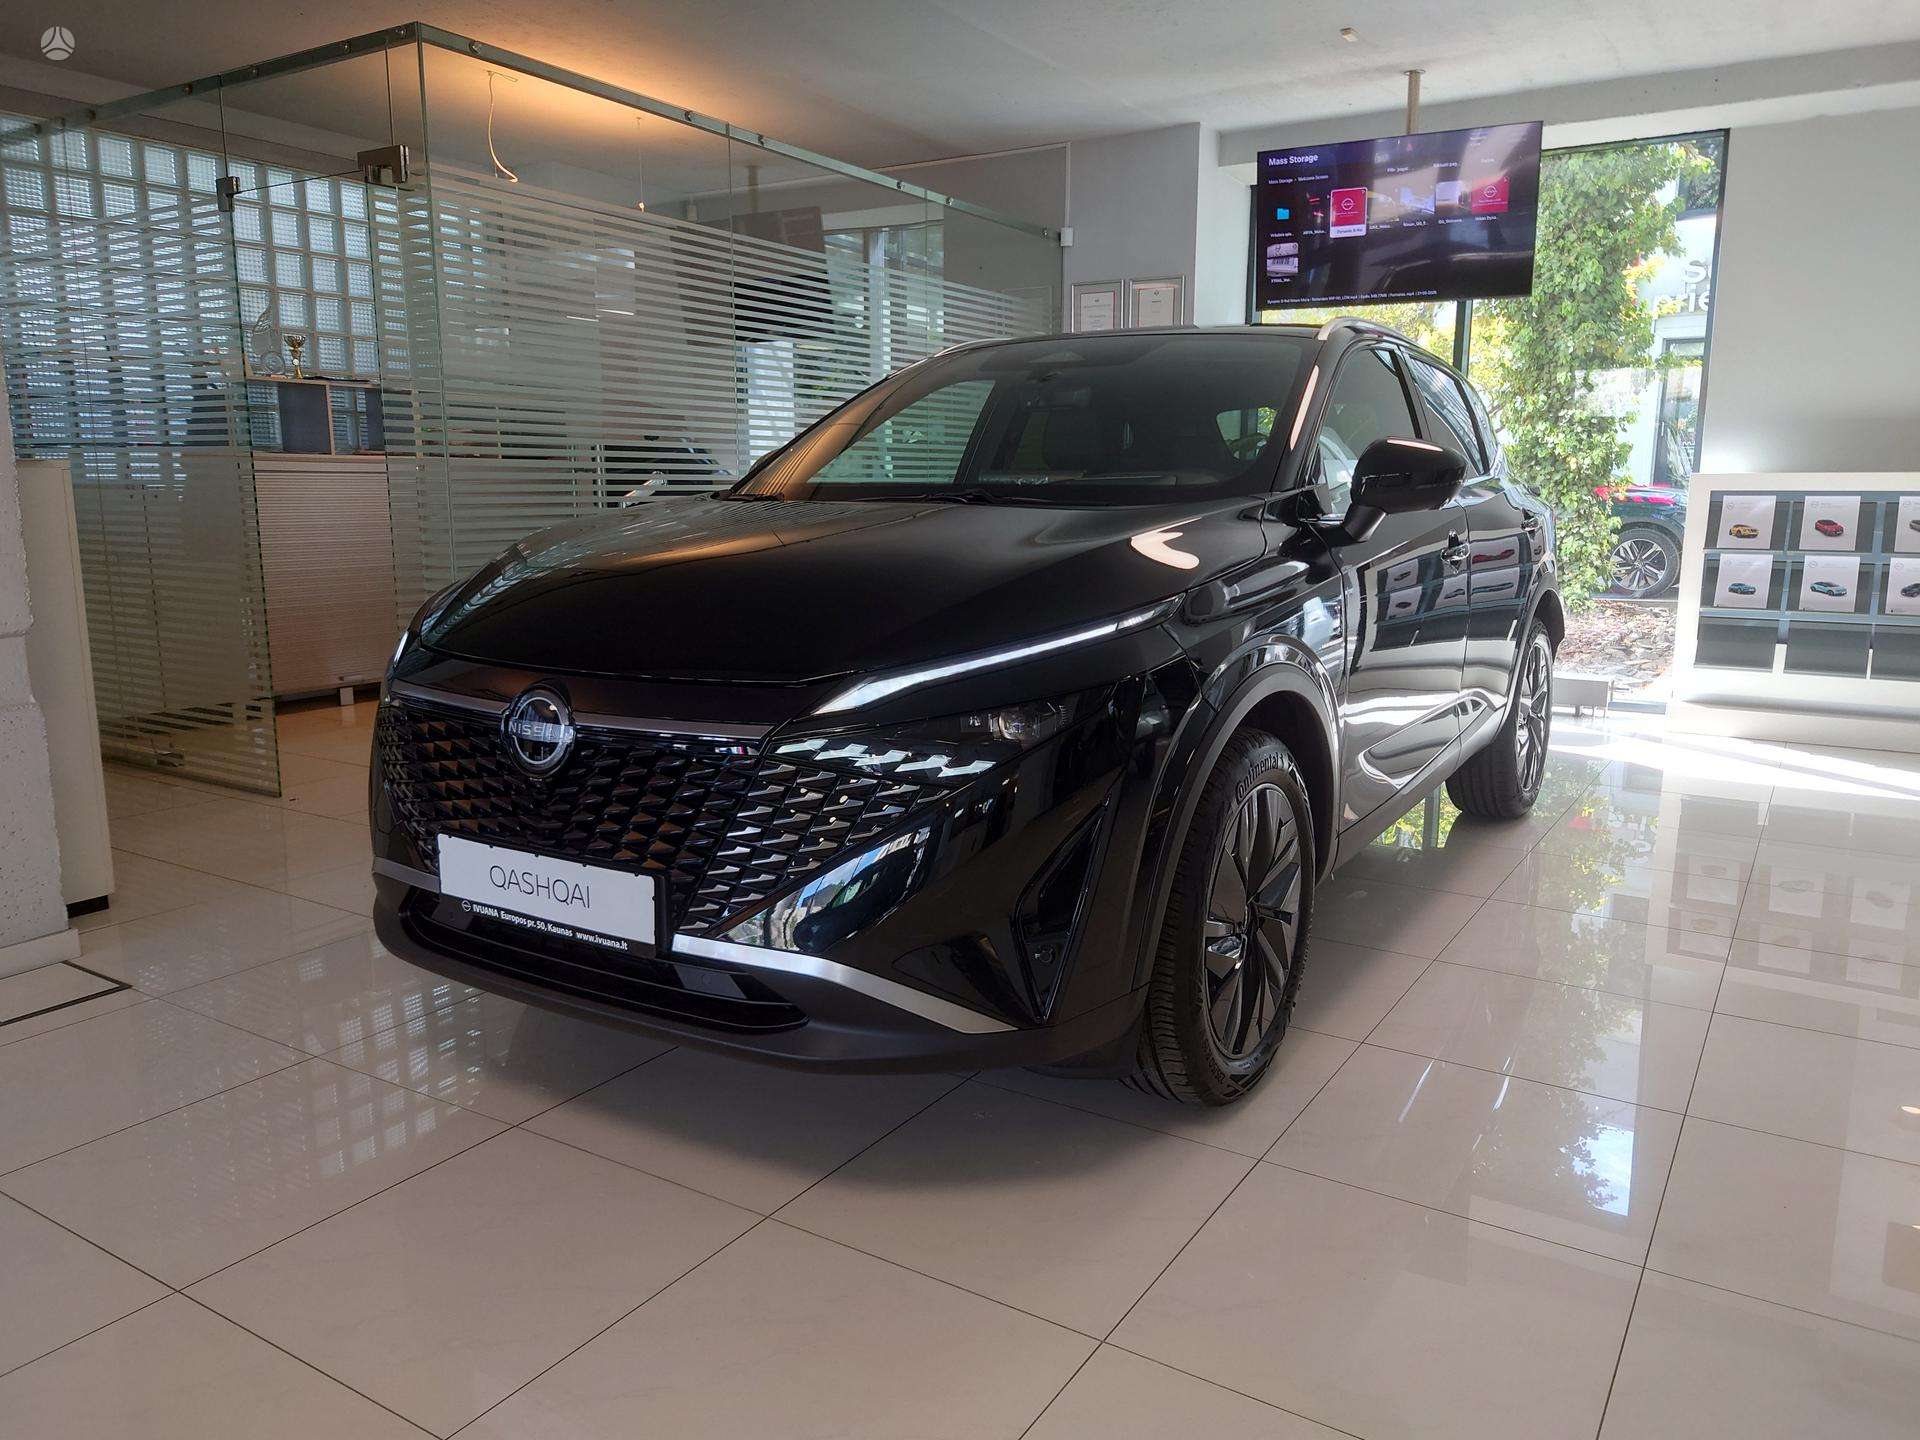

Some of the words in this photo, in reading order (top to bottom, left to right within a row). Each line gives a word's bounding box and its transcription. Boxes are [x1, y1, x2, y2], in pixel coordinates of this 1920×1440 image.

[1268, 156, 1288, 166] Mass
[1289, 154, 1319, 165] Storage
[1235, 751, 1280, 806] Continental
[489, 865, 590, 909] QASHQAI
[472, 904, 499, 918] IVUANA
[500, 910, 527, 926] Europos
[527, 917, 537, 929] pr.
[536, 920, 547, 932] 50,
[547, 923, 573, 938] Kaunas
[576, 930, 629, 951] www.ivuana.lt
